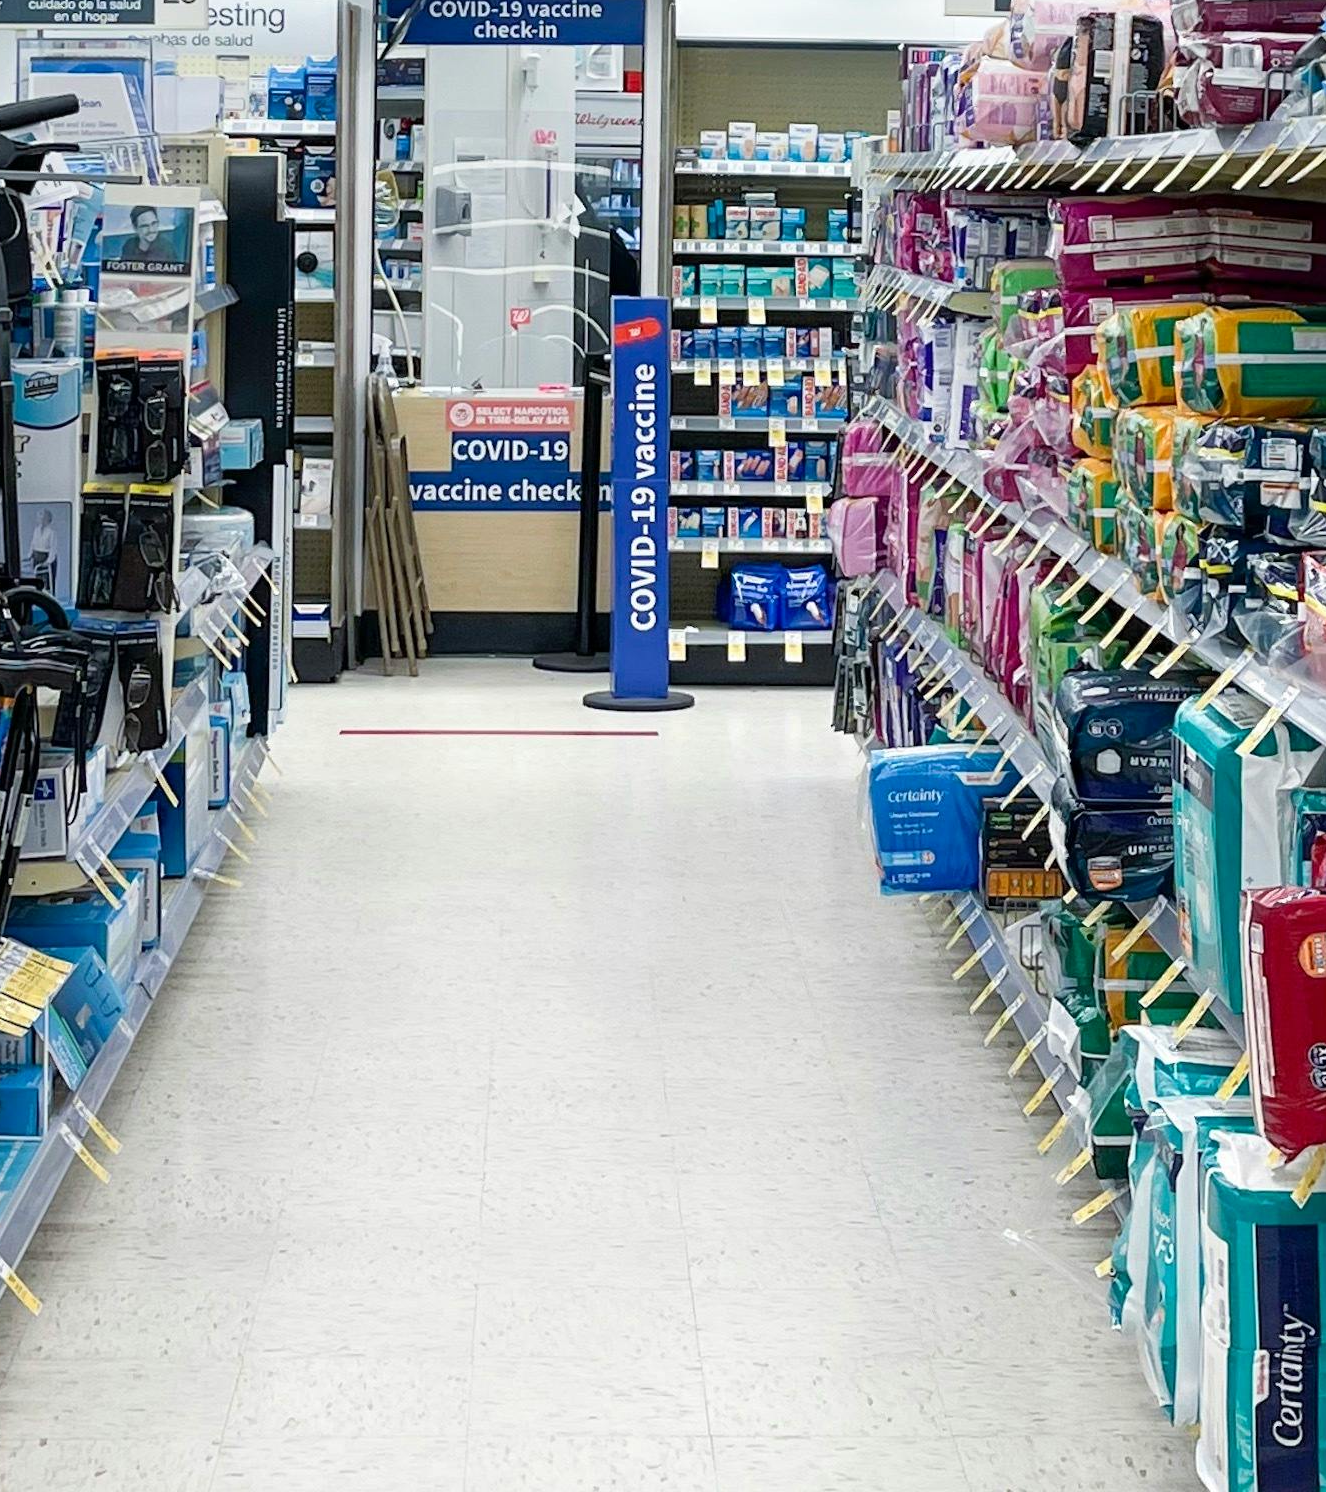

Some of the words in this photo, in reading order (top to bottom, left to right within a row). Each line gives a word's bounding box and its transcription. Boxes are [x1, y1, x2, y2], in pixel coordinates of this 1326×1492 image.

[54, 13, 69, 22] en
[72, 11, 82, 22] el
[85, 11, 119, 24] hogar
[207, 2, 286, 33] esting
[429, 1, 523, 18] COVID-19
[526, 0, 603, 19] vaccine
[473, 20, 558, 40] check-in
[191, 34, 211, 47] de
[214, 34, 254, 47] salud
[106, 261, 145, 273] FOSTER
[147, 262, 185, 274] GRANT
[544, 416, 570, 425] SAFE
[628, 363, 657, 479] vaccine
[452, 439, 569, 462] COVID-19
[410, 479, 505, 502] vaccine
[509, 478, 611, 502] checkn
[630, 486, 657, 631] COVID-19
[887, 789, 945, 806] Certainty
[1272, 1304, 1317, 1447] Certainty
